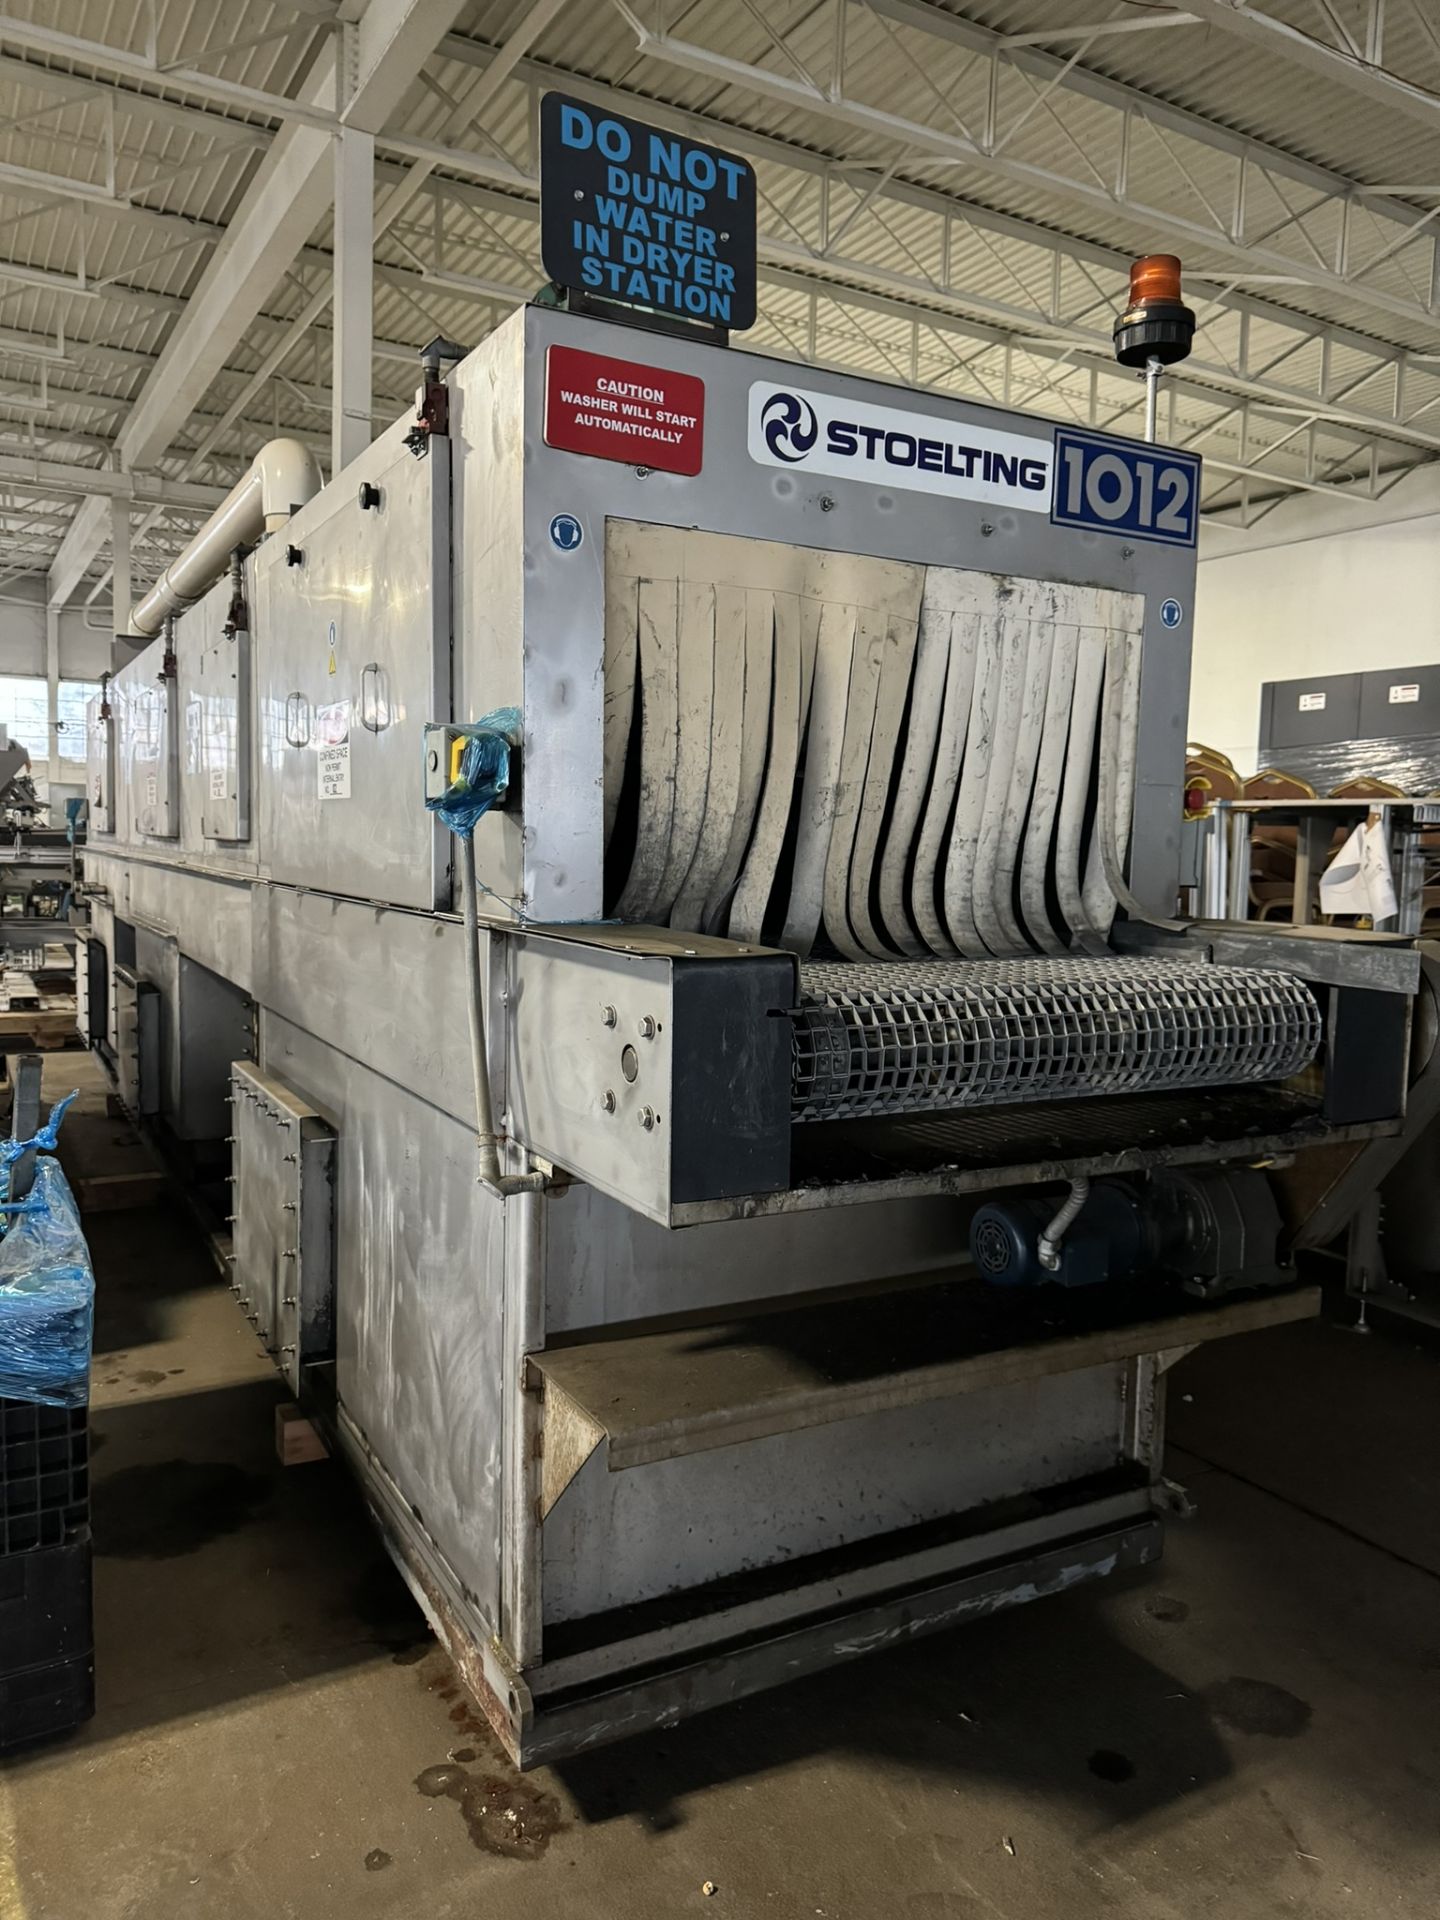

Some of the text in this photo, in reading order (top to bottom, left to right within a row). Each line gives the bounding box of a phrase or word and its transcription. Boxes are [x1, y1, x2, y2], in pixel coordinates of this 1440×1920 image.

[561, 104, 747, 200] DO NOT
[608, 165, 706, 218] DUMP
[573, 220, 736, 293] IN DRYER
[595, 194, 718, 257] WATER
[581, 256, 731, 321] STATION
[560, 390, 697, 429] WASHER WILL START
[596, 377, 665, 403] CAUTION
[574, 412, 683, 444] AUTOMATICALLY
[826, 420, 1047, 491] STOELTING
[1064, 446, 1190, 533] 1012
